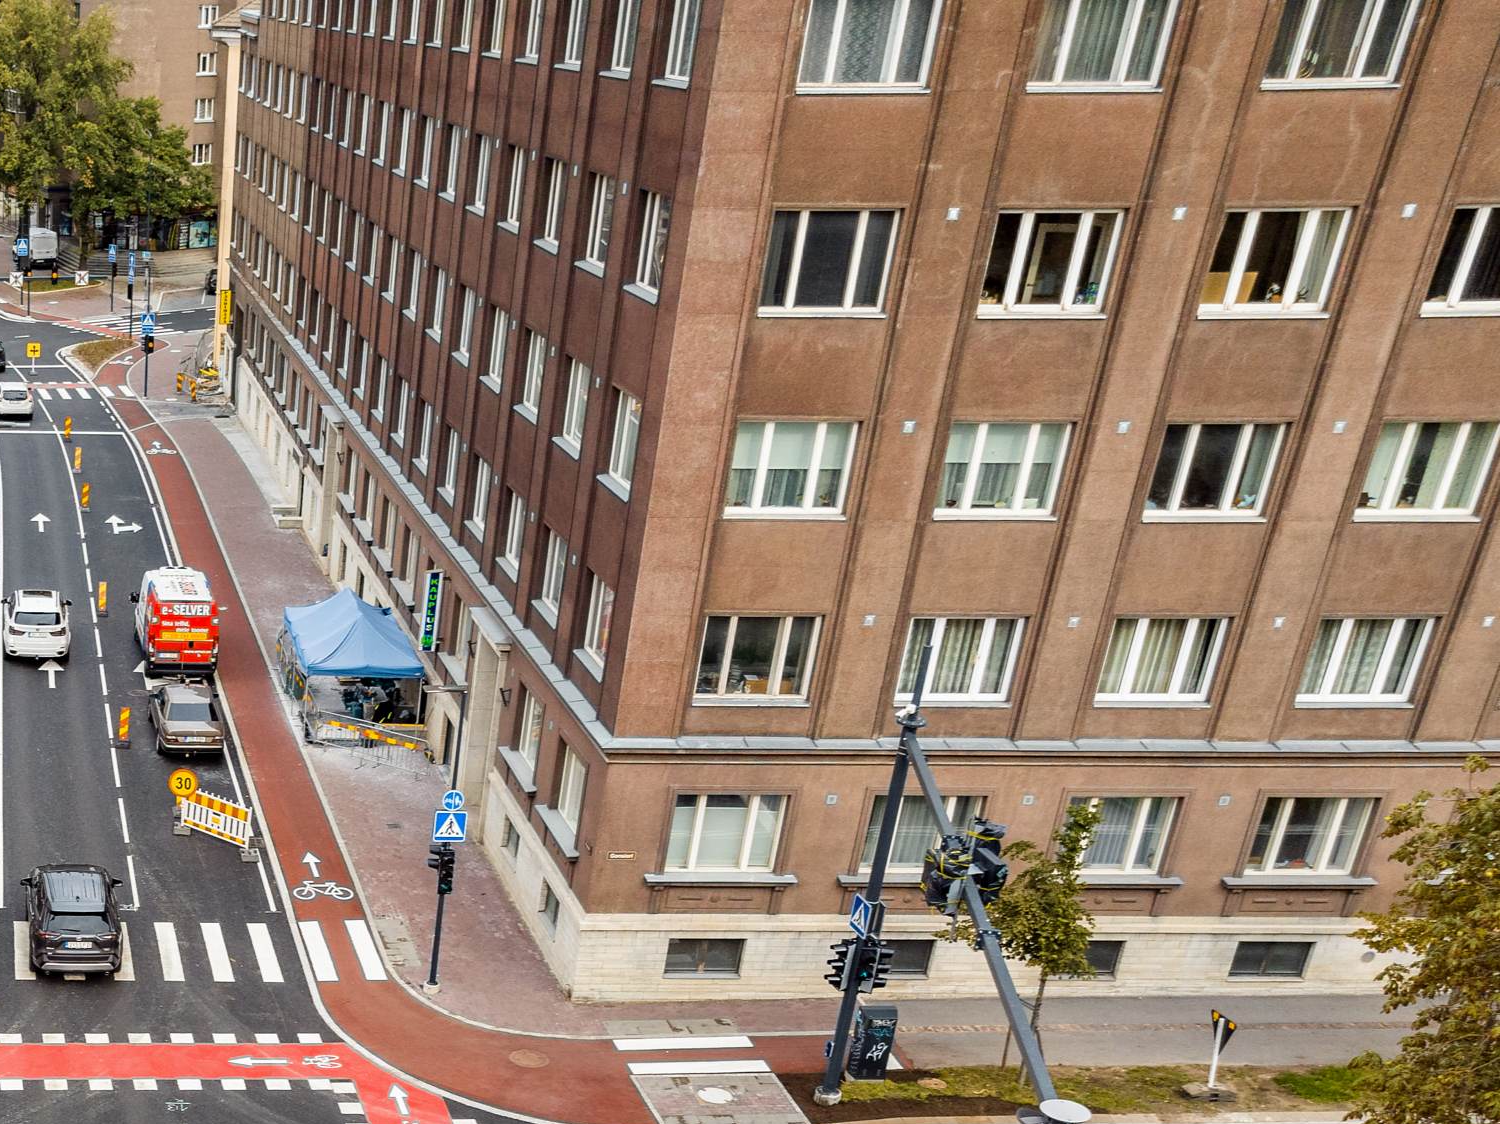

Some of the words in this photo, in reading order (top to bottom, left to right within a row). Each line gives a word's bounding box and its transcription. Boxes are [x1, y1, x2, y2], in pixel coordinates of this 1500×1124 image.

[162, 604, 210, 616] e-SELVER
[425, 579, 439, 631] KAUPLUS
[175, 777, 192, 790] 30
